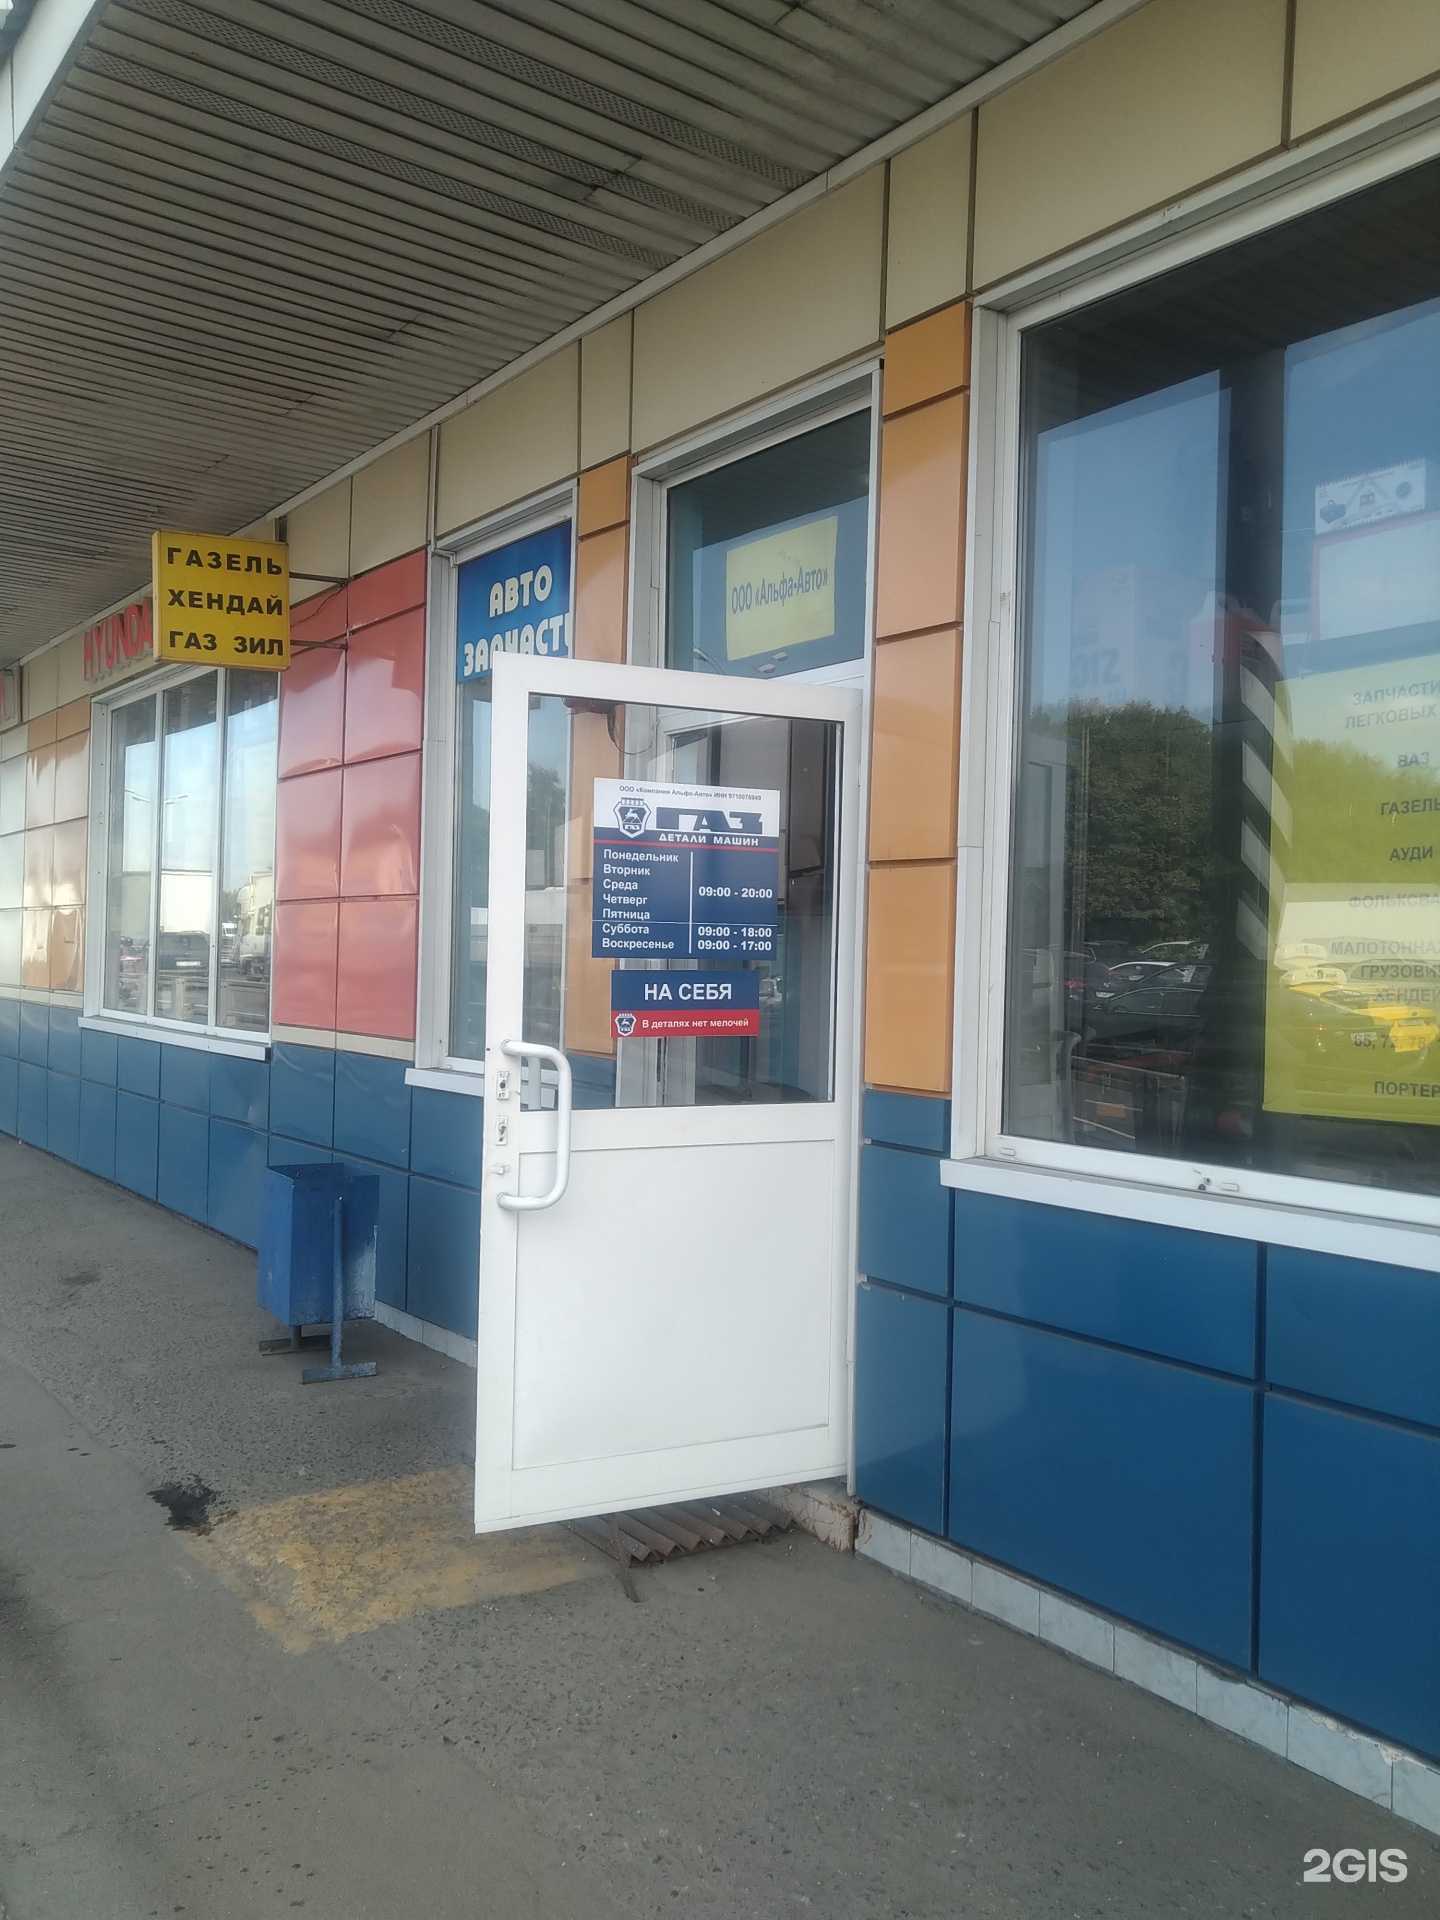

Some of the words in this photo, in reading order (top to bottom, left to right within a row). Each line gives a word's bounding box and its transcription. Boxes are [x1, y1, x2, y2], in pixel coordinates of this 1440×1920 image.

[167, 547, 283, 575] ГАЗЕЛЬ
[489, 565, 552, 618] АВТО
[167, 589, 283, 616] ХЕНДАЙ
[732, 582, 753, 615] ООО
[169, 631, 217, 651] ГАЗ
[234, 636, 284, 656] ЗИЛ
[656, 806, 763, 835] ГАЗ
[658, 832, 707, 844] ДЕТАЛИ
[713, 836, 760, 847] МАШИН
[603, 849, 679, 863] Понедельник
[1390, 846, 1433, 863] АУДИ
[603, 864, 651, 876] Вторник
[603, 878, 638, 891] Среда
[698, 886, 731, 897] 09:00
[741, 887, 773, 898] 20:00
[603, 893, 648, 905] Четверг
[602, 908, 650, 920] Пятница
[602, 923, 650, 936] Суббота
[698, 926, 731, 937] 09:00
[742, 927, 772, 938] 18:00
[602, 938, 675, 951] Воскресенье
[697, 939, 730, 950] 09:00
[741, 940, 772, 951] 17:00
[644, 984, 673, 1001] НА
[678, 983, 732, 1001] СЕБЯ
[642, 1020, 649, 1028] В
[651, 1020, 690, 1029] деталях
[692, 1020, 708, 1028] нет
[710, 1018, 749, 1027] мелочей
